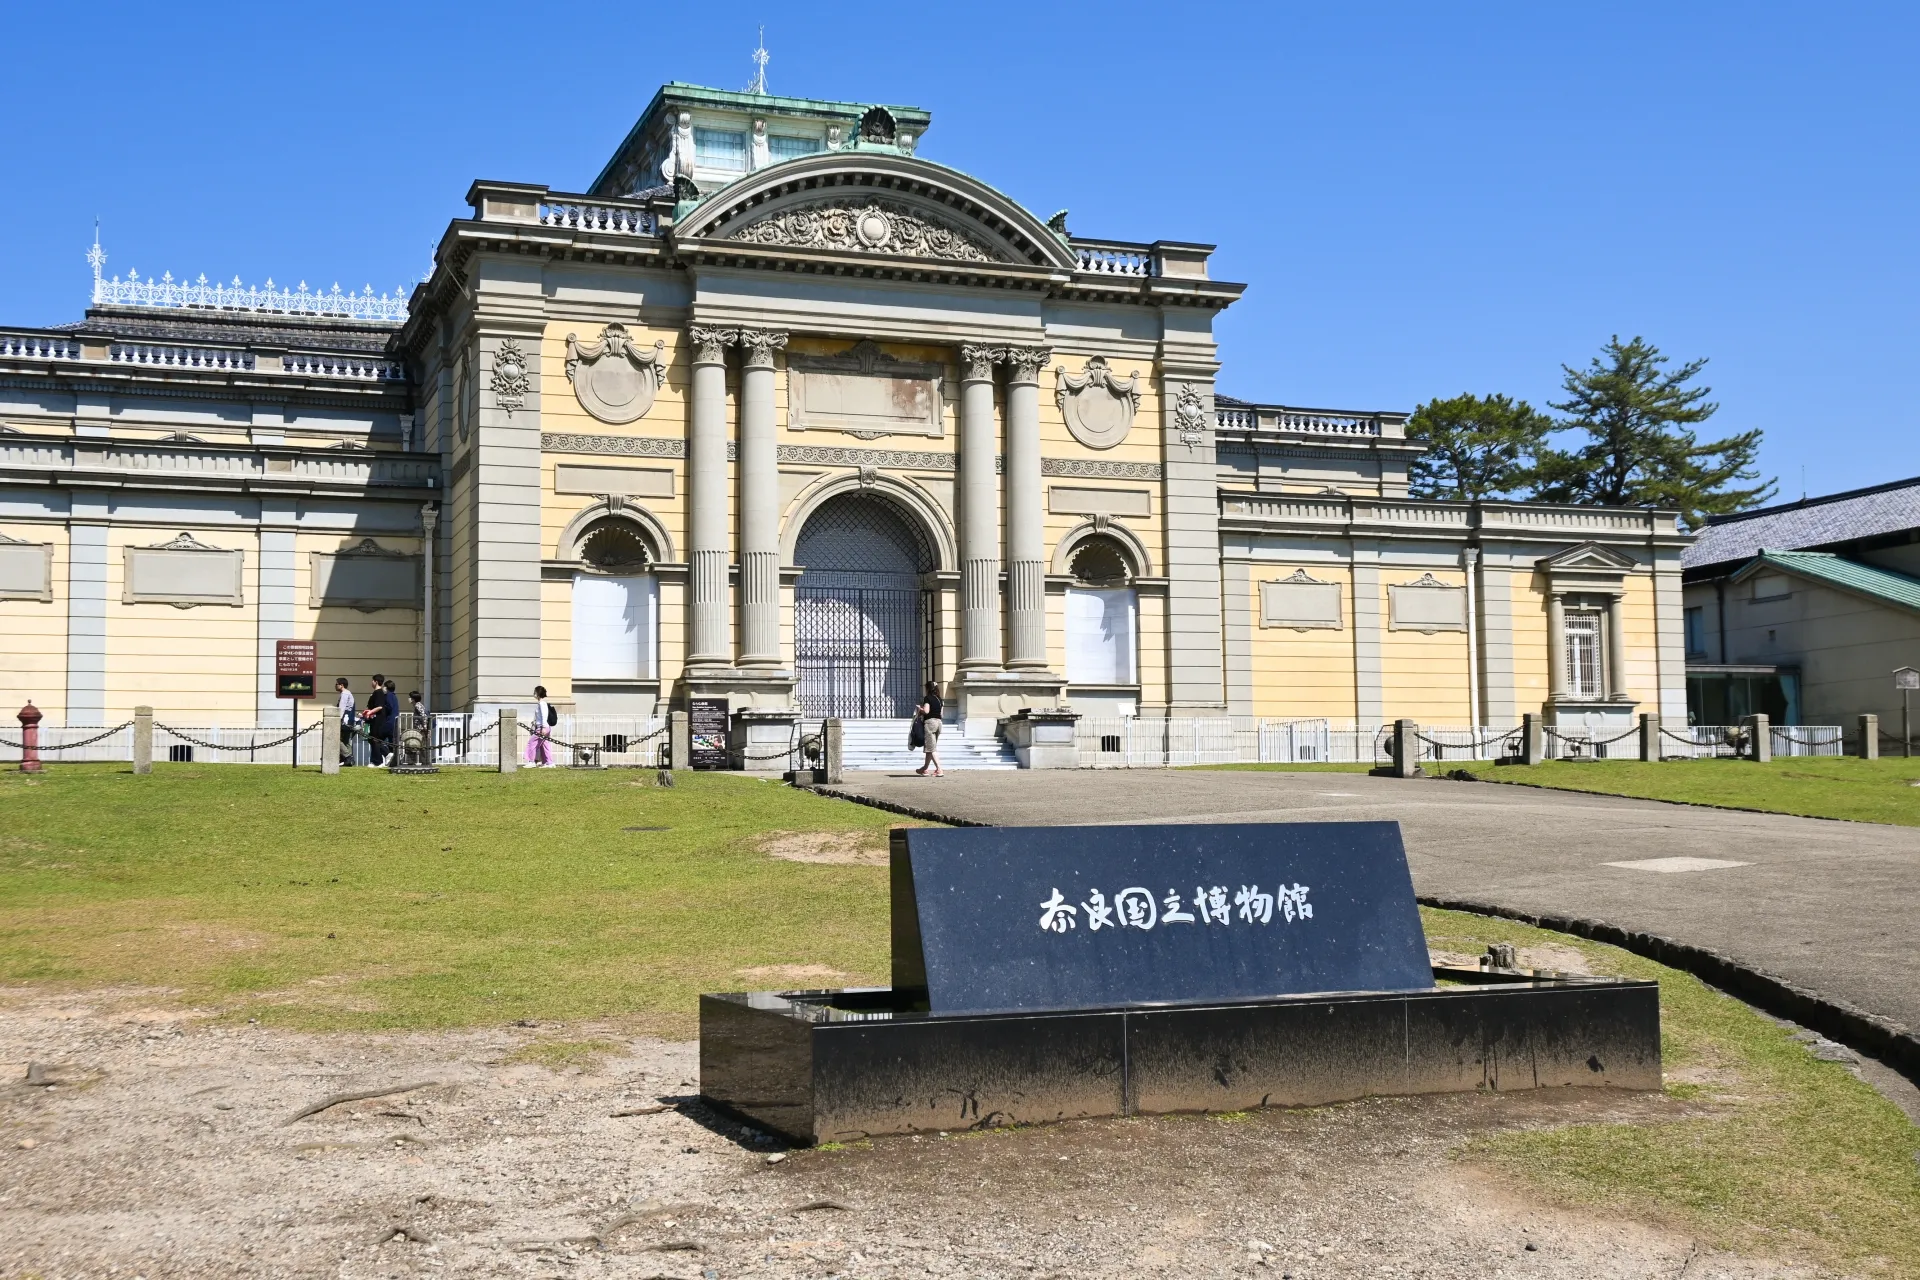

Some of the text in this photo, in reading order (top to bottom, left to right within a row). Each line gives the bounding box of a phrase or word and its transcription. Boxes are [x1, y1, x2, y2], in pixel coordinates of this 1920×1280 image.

[1039, 882, 1314, 933] 奈良国立博物館
